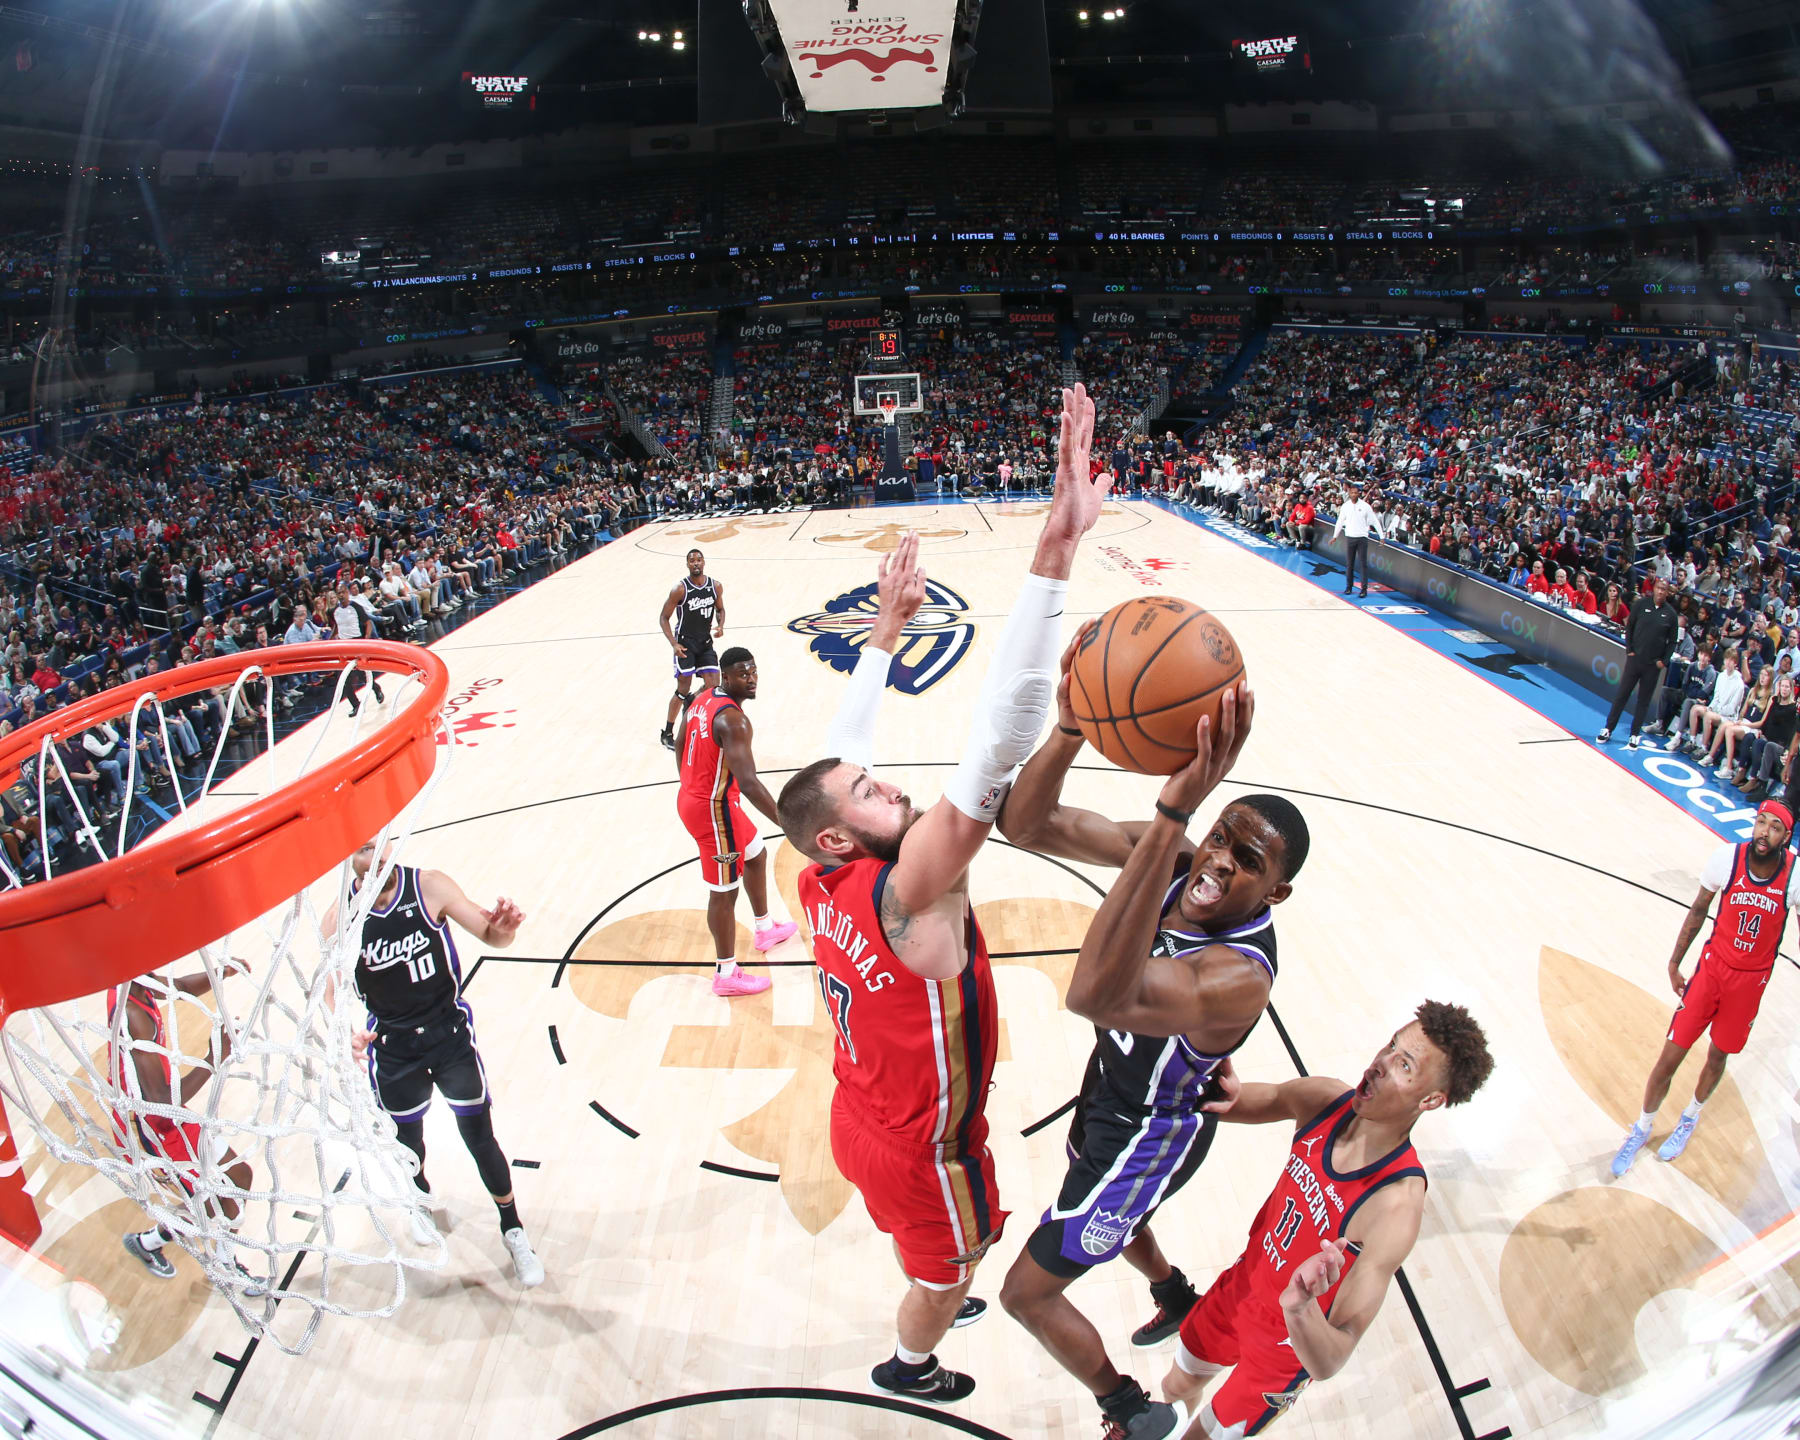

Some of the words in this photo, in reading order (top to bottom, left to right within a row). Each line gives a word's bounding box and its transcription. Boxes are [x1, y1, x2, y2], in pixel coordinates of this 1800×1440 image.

[831, 16, 905, 25] CENTER
[792, 34, 944, 49] SMOOTHIE
[1241, 36, 1297, 52] HUSTLE
[1246, 44, 1294, 57] STATS
[1256, 57, 1285, 66] CAESARS
[471, 76, 528, 86] HUSTLE
[475, 84, 523, 92] STATS
[848, 237, 859, 245] 15
[931, 233, 938, 241] 4
[957, 232, 994, 240] KINGS
[1131, 232, 1166, 240] BARNES
[1181, 233, 1209, 241] POINTS
[1213, 233, 1219, 241] 0
[1230, 232, 1273, 241] REBOUNDS
[1292, 233, 1326, 241] ASSISTS
[1328, 233, 1334, 241] 0
[1346, 232, 1374, 240] STEALS
[1377, 232, 1383, 240] 0
[1392, 232, 1423, 240] BLOCKS
[1427, 232, 1433, 240] 0
[383, 280, 390, 288] J.
[391, 276, 442, 287] VALANCIUNAS
[440, 274, 467, 282] POINTS
[471, 273, 478, 281] 2
[489, 267, 532, 278] REBOUNDS
[535, 266, 541, 274] 3
[551, 263, 583, 272] ASSISTS
[604, 257, 635, 268] STEALS
[638, 256, 644, 265] 0
[653, 253, 686, 263] BLOCKS
[689, 252, 695, 260] 0
[1104, 284, 1126, 292] COX
[1248, 286, 1270, 294] COX
[1388, 288, 1408, 296] COX
[1521, 288, 1541, 297] COX
[1643, 283, 1663, 294] COX
[523, 319, 545, 328] COX
[826, 316, 881, 331] SEATGEEK
[916, 312, 943, 325] Let's
[944, 312, 960, 324] Go
[1009, 312, 1056, 324] SEATGEEK
[1092, 312, 1118, 323] Let's
[1119, 312, 1135, 323] Go
[1189, 313, 1241, 325] SEATGEEK
[739, 325, 765, 337] Let's
[766, 323, 782, 335] Go
[879, 332, 897, 341] 8:14
[1620, 327, 1661, 335] BETRIVERS
[385, 333, 407, 344] COX
[652, 331, 707, 346] SEATGEEK
[558, 343, 582, 357] Let's
[583, 342, 599, 354] Go
[882, 340, 896, 354] 19
[1369, 552, 1393, 575] COX
[1427, 577, 1457, 605] COX
[687, 596, 715, 611] Kings
[1500, 610, 1537, 644] COX
[1592, 655, 1620, 685] CO
[687, 729, 697, 767] 1
[1730, 892, 1779, 915] CRESCENT
[1737, 910, 1762, 939] 14
[360, 929, 430, 972] Kings
[1733, 937, 1756, 953] CITY
[405, 952, 436, 983] 10
[1285, 1153, 1331, 1237] CRESCENT
[1324, 1182, 1345, 1214] ibotta
[1274, 1195, 1304, 1252] 11
[1085, 1225, 1123, 1241] KINGS
[1263, 1231, 1287, 1272] CITY
